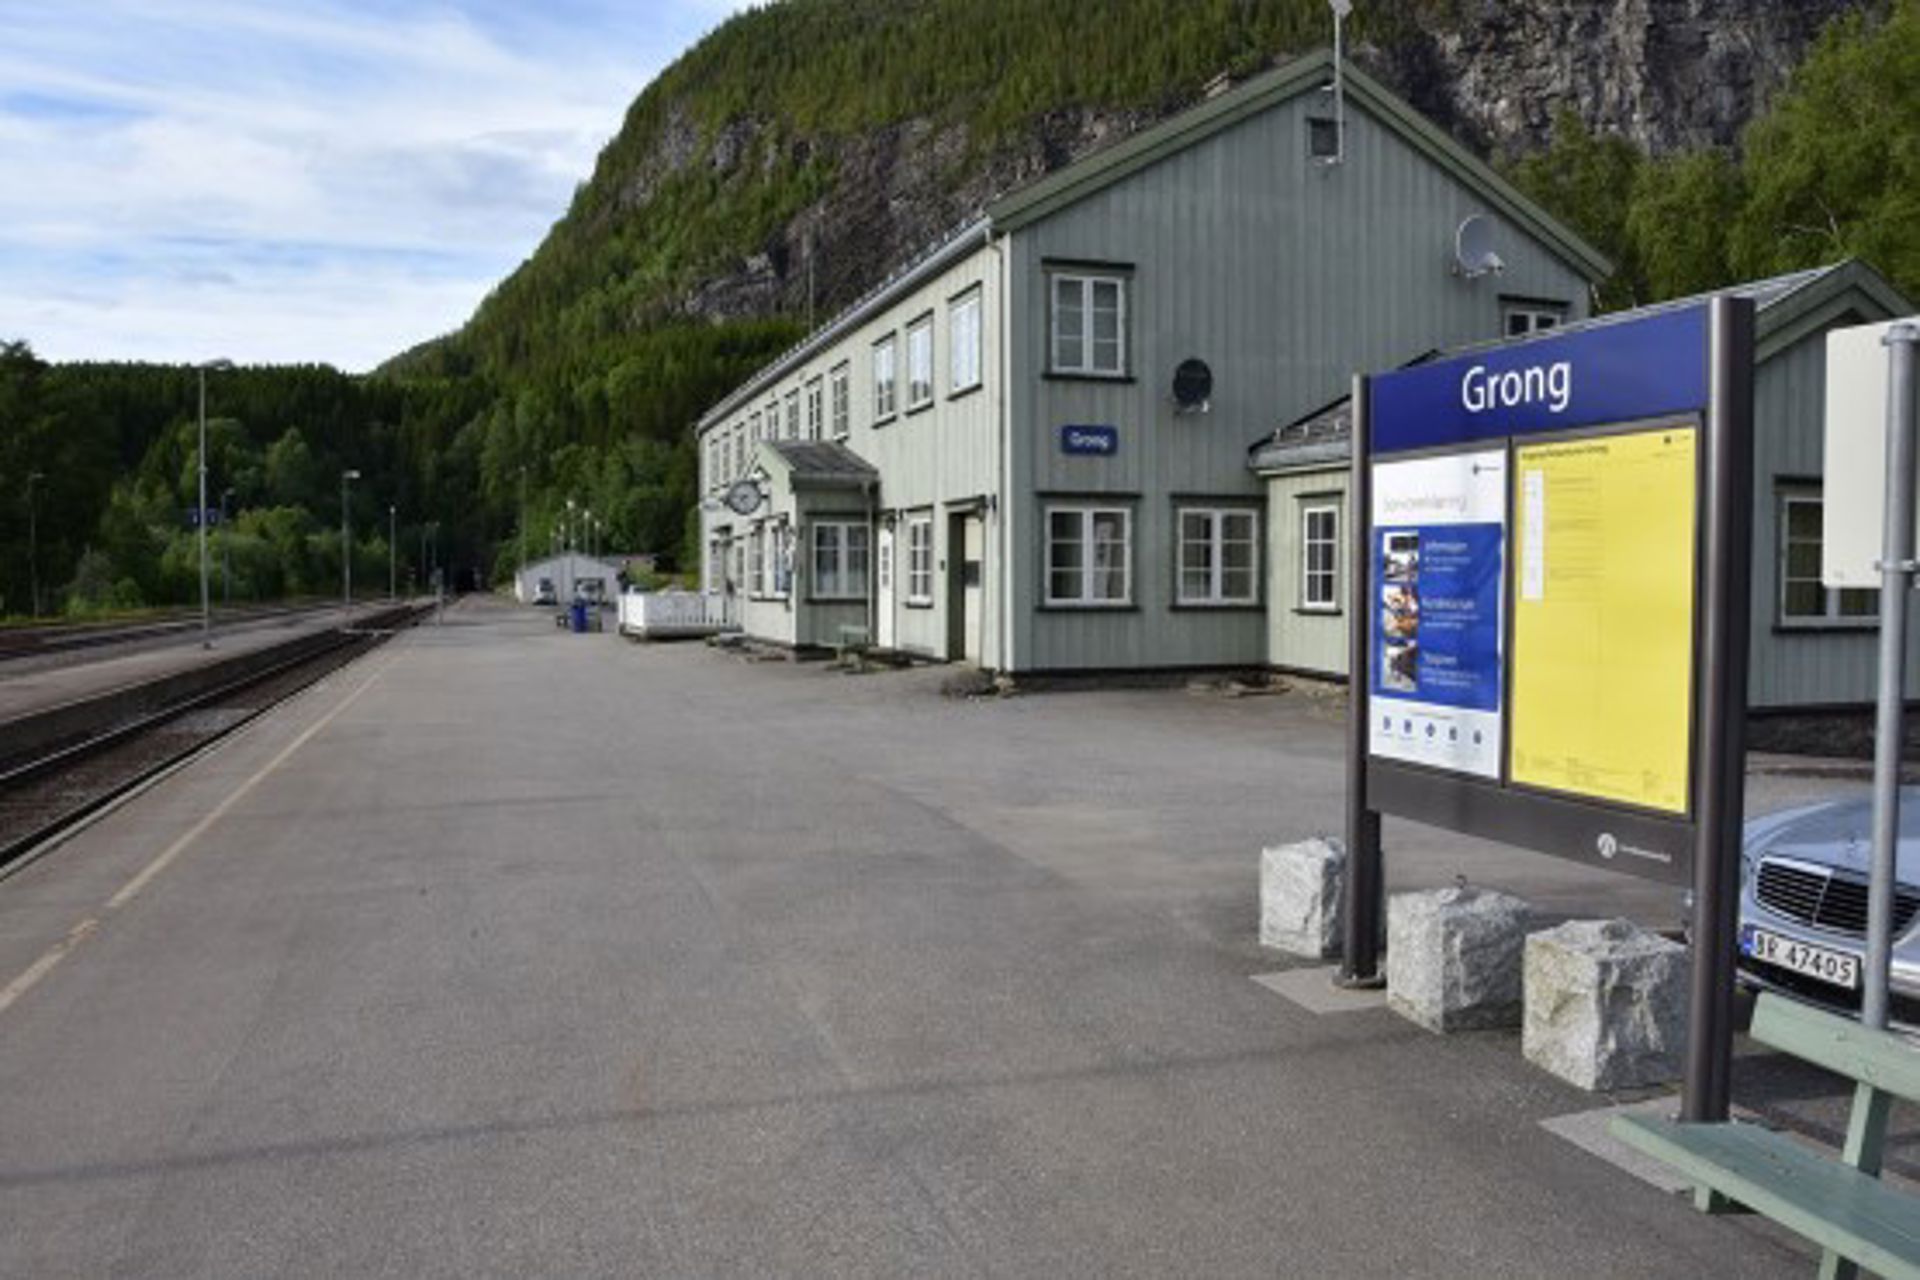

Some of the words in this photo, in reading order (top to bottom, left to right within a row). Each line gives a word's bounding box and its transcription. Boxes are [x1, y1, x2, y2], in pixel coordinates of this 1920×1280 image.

[1462, 362, 1571, 413] Grong
[1068, 431, 1109, 451] Grong
[1785, 944, 1852, 983] 47405
